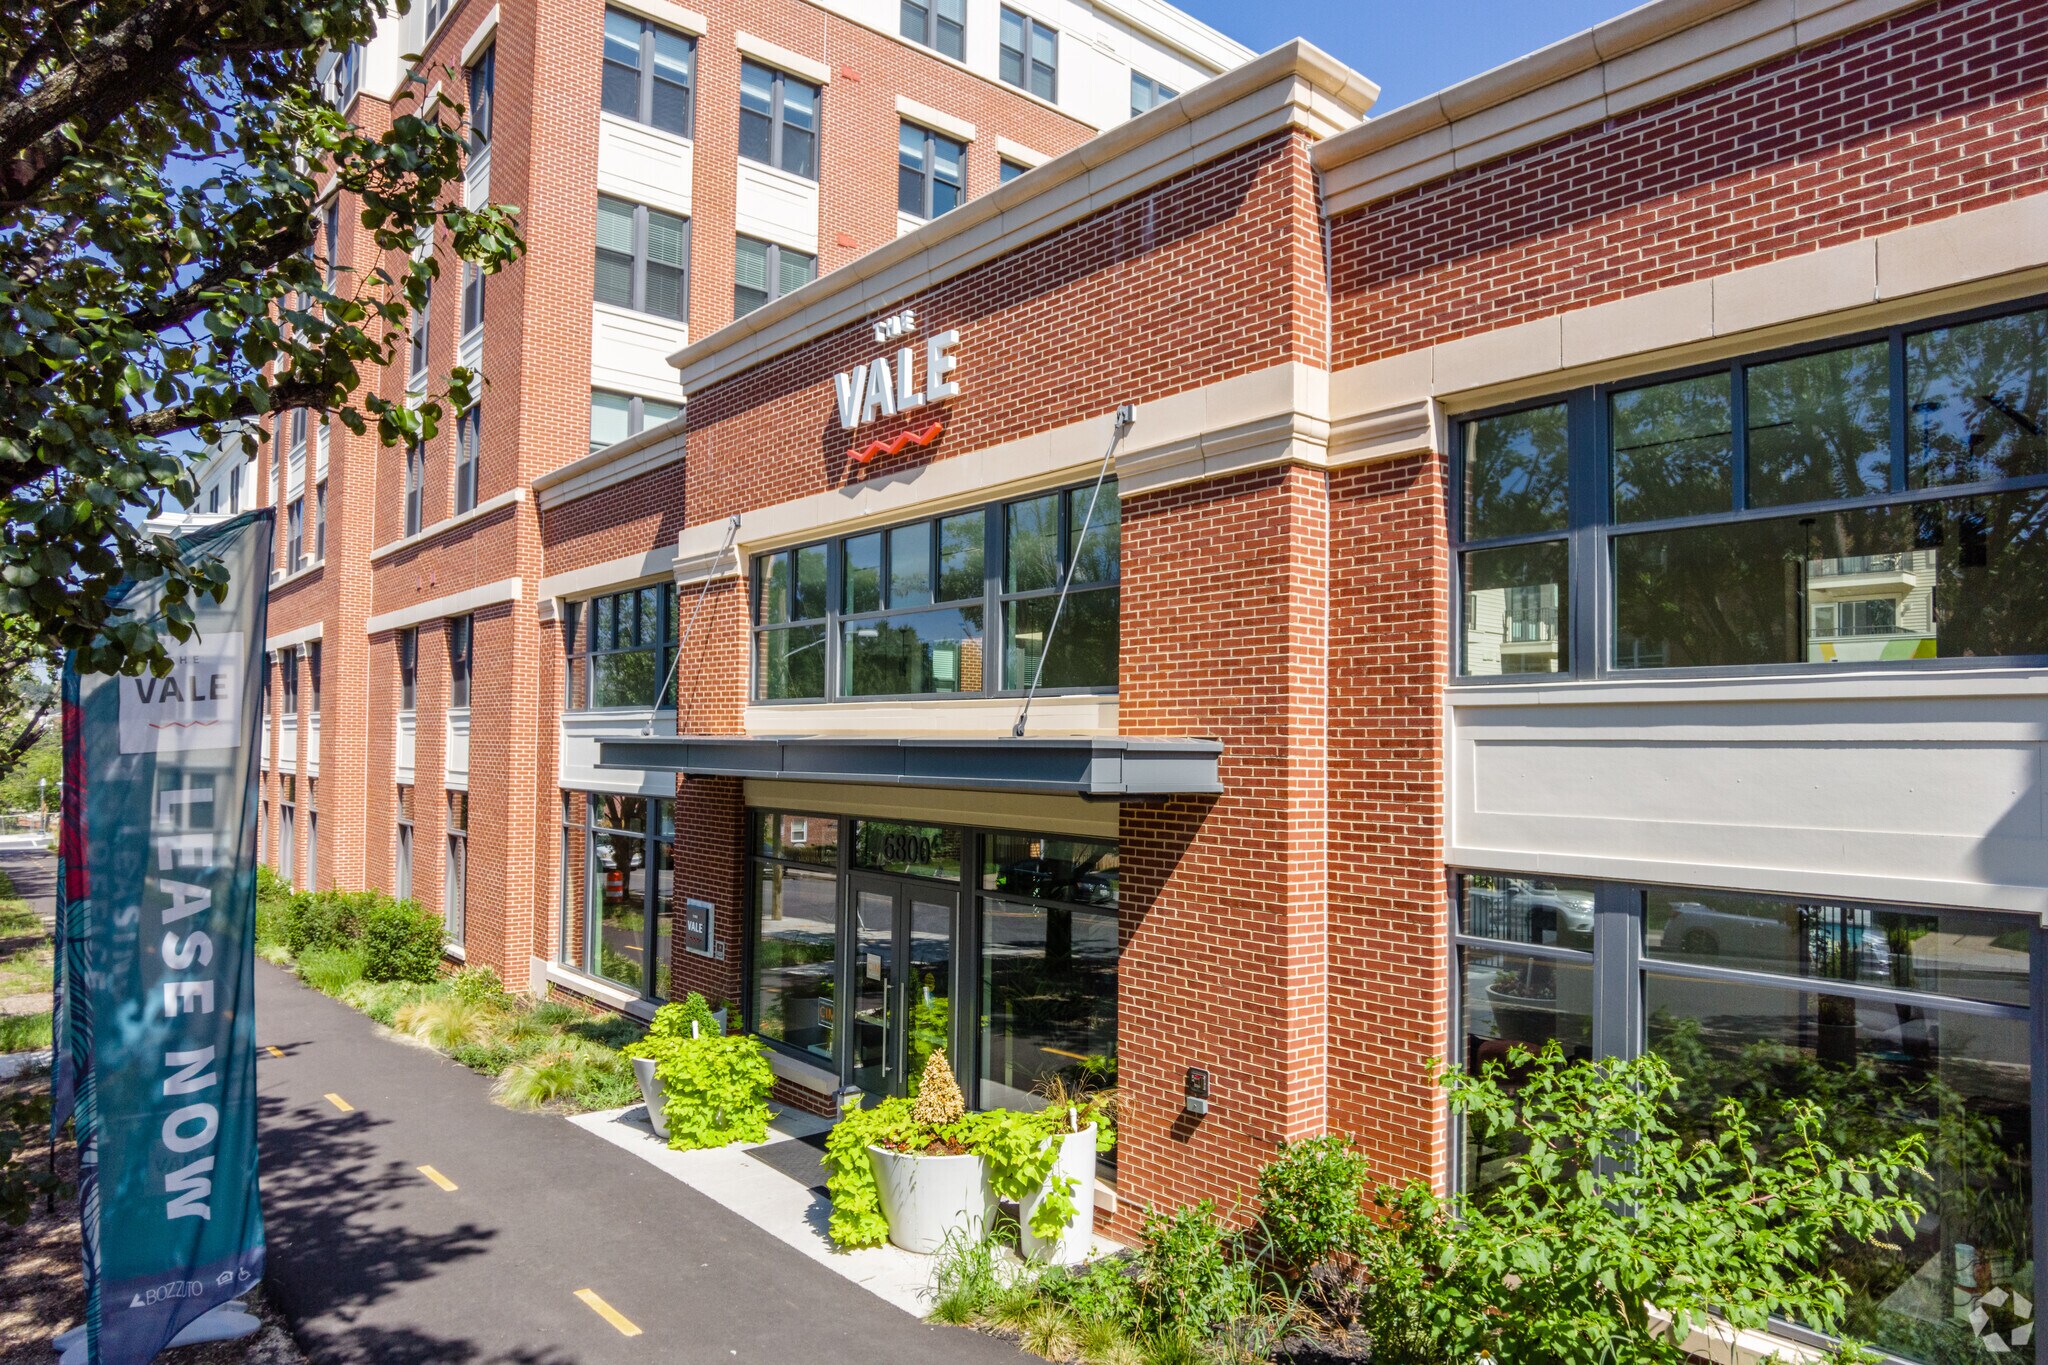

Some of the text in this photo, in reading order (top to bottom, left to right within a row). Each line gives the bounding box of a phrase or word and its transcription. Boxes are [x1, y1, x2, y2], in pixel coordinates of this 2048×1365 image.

[872, 309, 916, 343] THE
[834, 329, 960, 430] VALE
[134, 674, 228, 704] VALE
[883, 833, 931, 865] 6800
[158, 787, 214, 1017] LEASE
[687, 920, 703, 934] VALE
[162, 1045, 219, 1221] NOW
[145, 1280, 203, 1306] BOZZUTO
